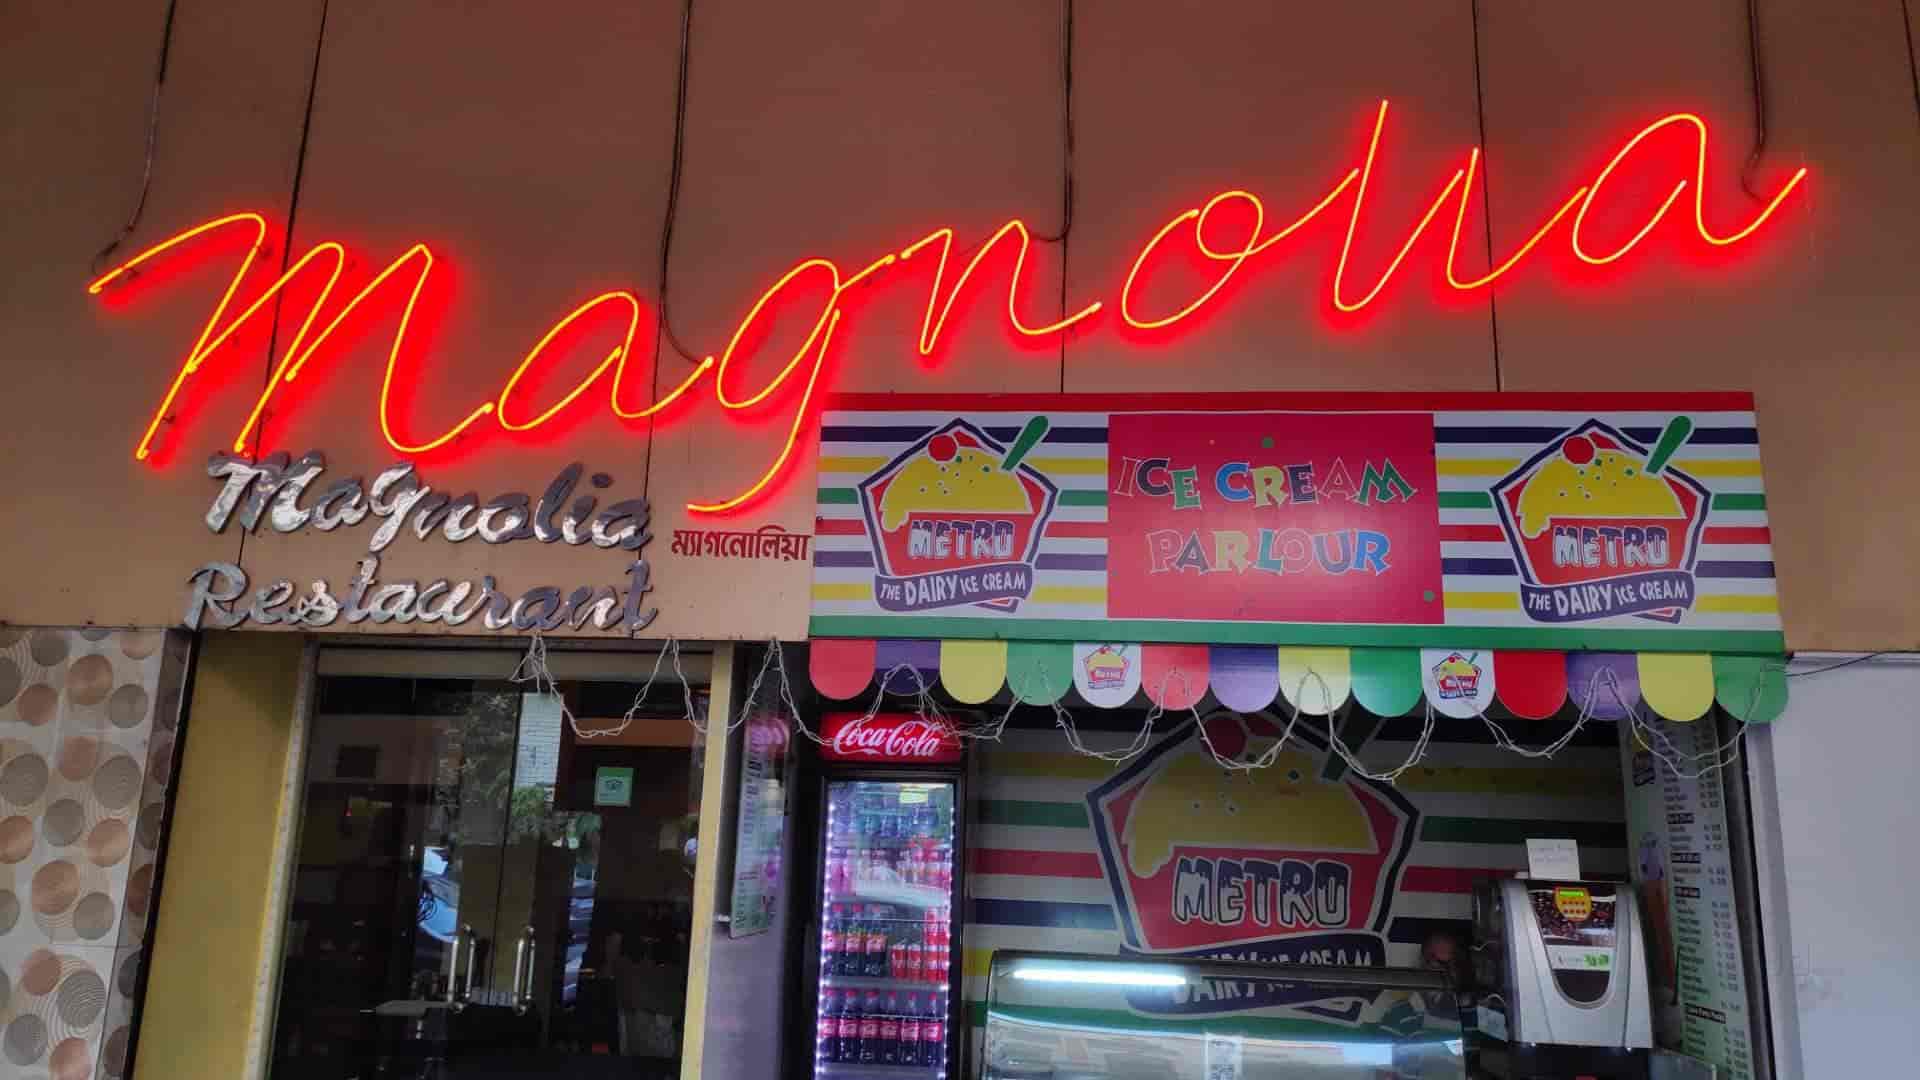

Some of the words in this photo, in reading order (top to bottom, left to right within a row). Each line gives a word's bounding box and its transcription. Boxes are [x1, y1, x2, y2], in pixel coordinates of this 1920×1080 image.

[207, 451, 656, 552] Magnolia
[1113, 456, 1202, 510] ICE
[1215, 456, 1418, 508] CREAM
[671, 524, 811, 562] ম্যাগনোলিয়া
[908, 519, 1016, 560] METRO
[1146, 527, 1392, 576] PARLOUR
[1552, 525, 1671, 568] METRO
[184, 550, 659, 634] Restaurant
[879, 583, 902, 601] THE
[903, 574, 960, 606] DAIRY
[960, 577, 980, 594] ICE
[982, 572, 1027, 593] CREAM
[1527, 591, 1551, 612] THE
[1553, 582, 1615, 617] DAIRY
[1614, 584, 1637, 606] ICE
[1639, 580, 1689, 602] CREAM
[1172, 855, 1352, 929] METRO
